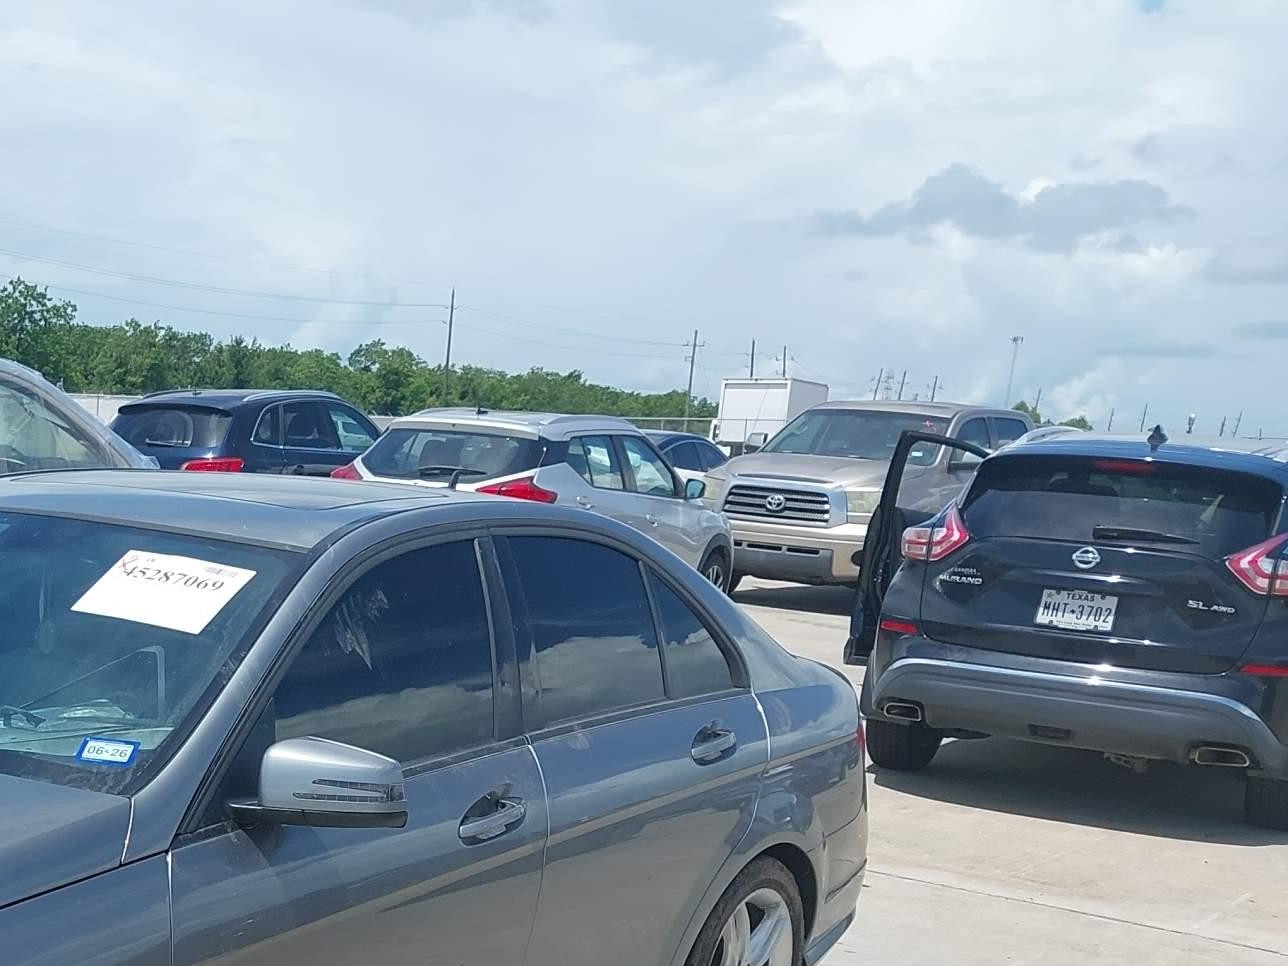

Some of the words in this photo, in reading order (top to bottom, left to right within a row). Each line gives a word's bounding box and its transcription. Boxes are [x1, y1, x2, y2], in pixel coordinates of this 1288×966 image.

[123, 565, 225, 592] 45287069
[1066, 592, 1096, 602] TEXAS
[1187, 600, 1209, 610] SL
